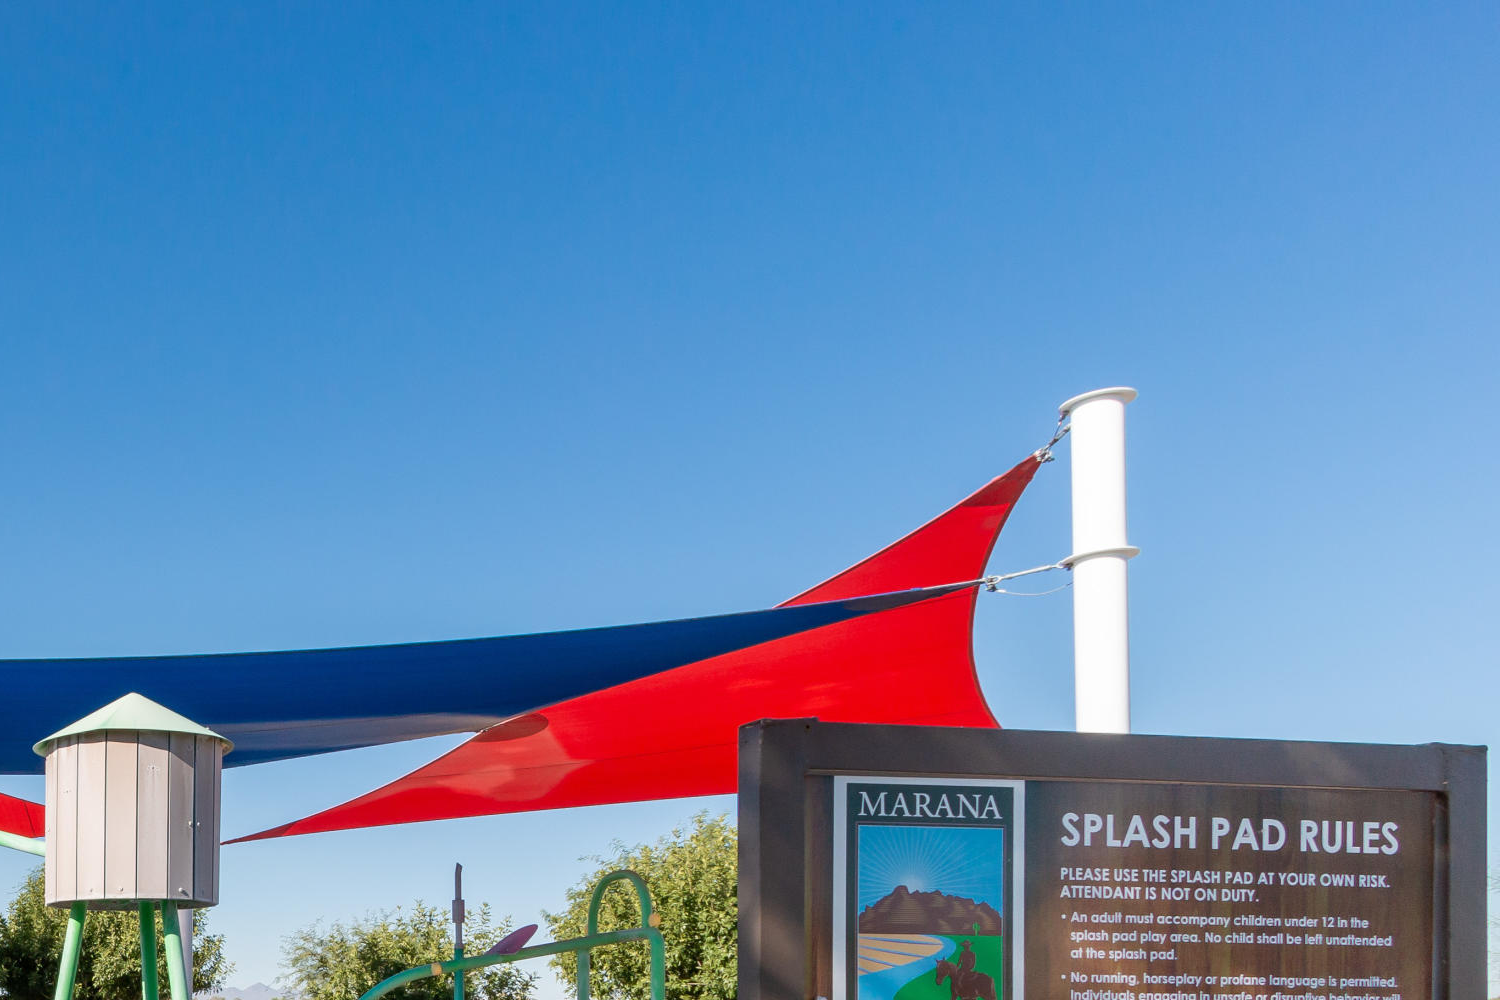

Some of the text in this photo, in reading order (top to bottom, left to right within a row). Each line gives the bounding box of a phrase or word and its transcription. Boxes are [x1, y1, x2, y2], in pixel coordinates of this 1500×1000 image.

[858, 791, 1003, 820] MARANA
[1061, 812, 1398, 855] SPLASH PAD RULES
[1060, 867, 1390, 887] PLEASE USE THE SPLASH PAD AT YOUR OWN RISK.
[1060, 885, 1258, 902] ATTENDANT IS NOT ON DUTY.
[1070, 911, 1368, 928] An adult must accompany children under 12 in the
[1070, 929, 1392, 946] splash pad play area. No child shall be left unattended
[1070, 947, 1177, 962] at the splash pad.
